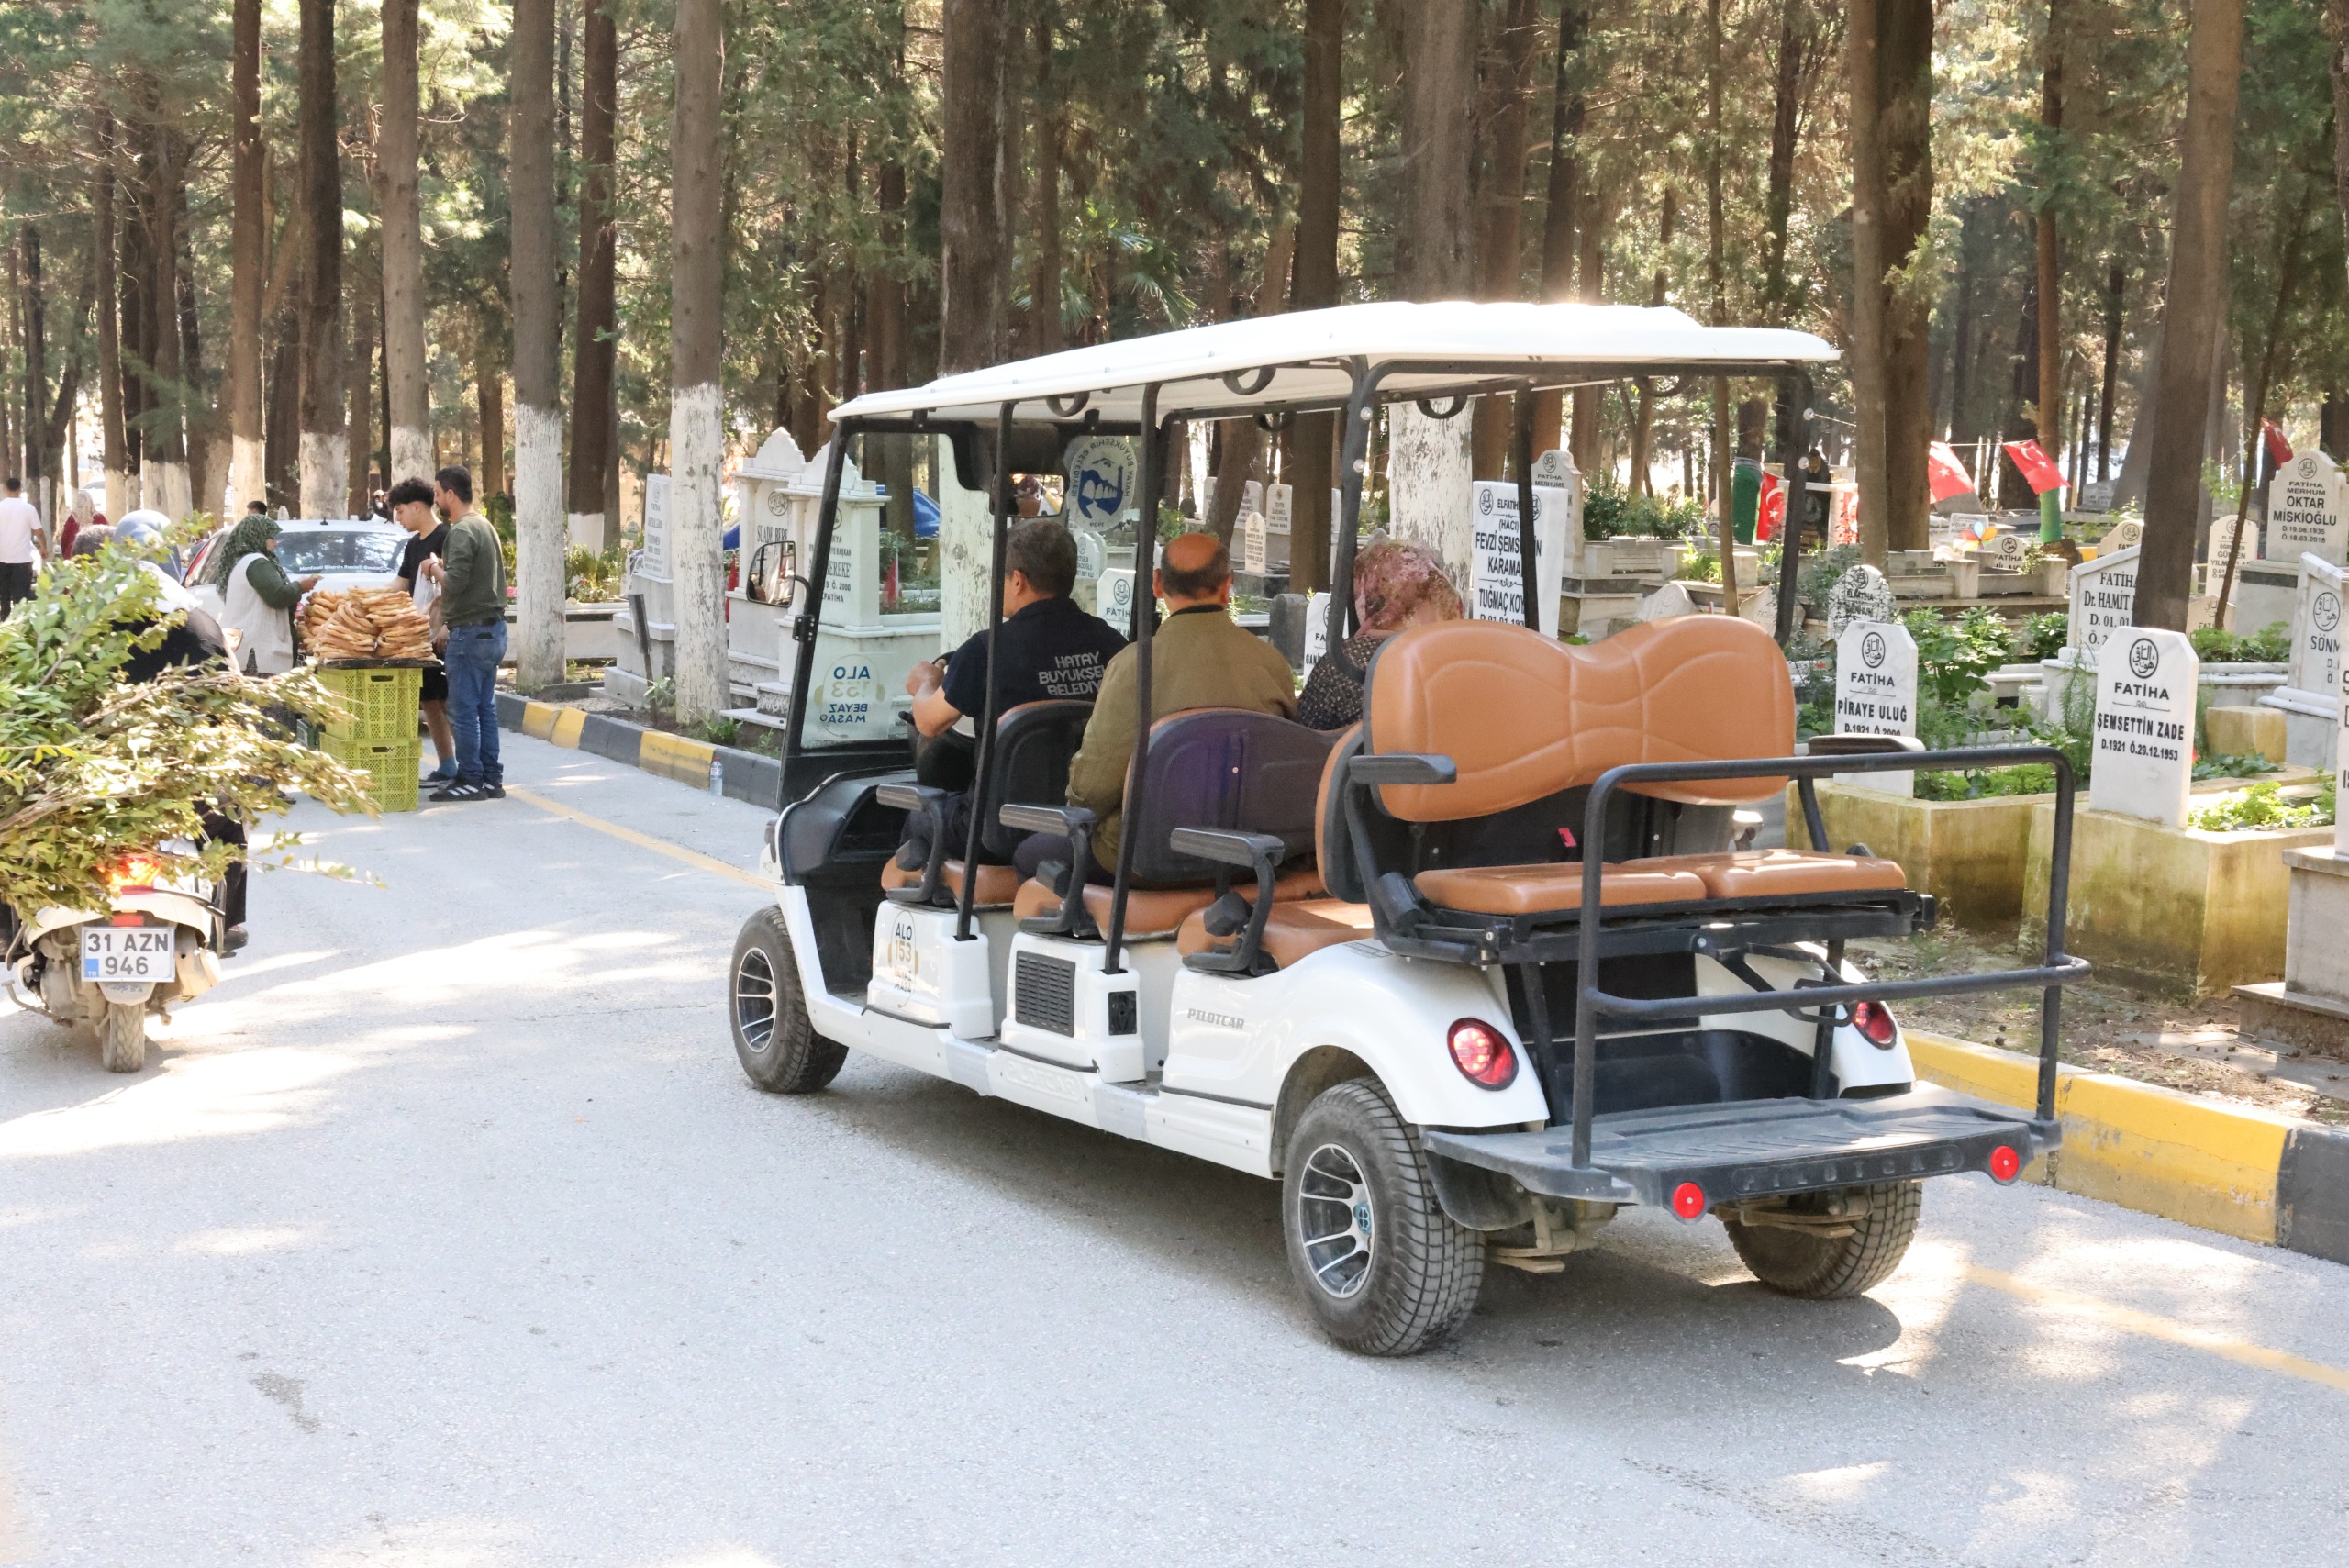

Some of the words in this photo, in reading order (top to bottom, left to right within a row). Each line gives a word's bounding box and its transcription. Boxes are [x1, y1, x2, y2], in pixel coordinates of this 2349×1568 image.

[1535, 480, 1565, 488] MERHUME
[2288, 480, 2323, 488] FATİHA
[2287, 495, 2325, 509] OKTAR
[2273, 509, 2337, 526] MİSKİOĞLU
[1475, 529, 1497, 551] FEVZİ
[1478, 585, 1508, 616] TUĞMAÇ
[2084, 590, 2096, 606] Dr.
[2098, 589, 2130, 611] HAMİT
[1054, 651, 1100, 669] HATAY
[1851, 672, 1895, 687] FATİHA
[2114, 682, 2170, 701] FATİHA
[1838, 697, 1875, 718] PİRAYE
[1879, 704, 1908, 723] ULUĞ
[2097, 712, 2154, 736] ŞEMSETTİN
[2156, 720, 2185, 741] ZADE
[2100, 738, 2126, 752] D.1921
[2130, 740, 2179, 762] Ö.29.12.1953
[895, 922, 913, 941] ALO
[87, 933, 112, 952] 31
[123, 933, 169, 952] AZN
[895, 940, 912, 962] 153
[105, 956, 149, 975] 946
[1187, 1007, 1245, 1029] PILOTCAR
